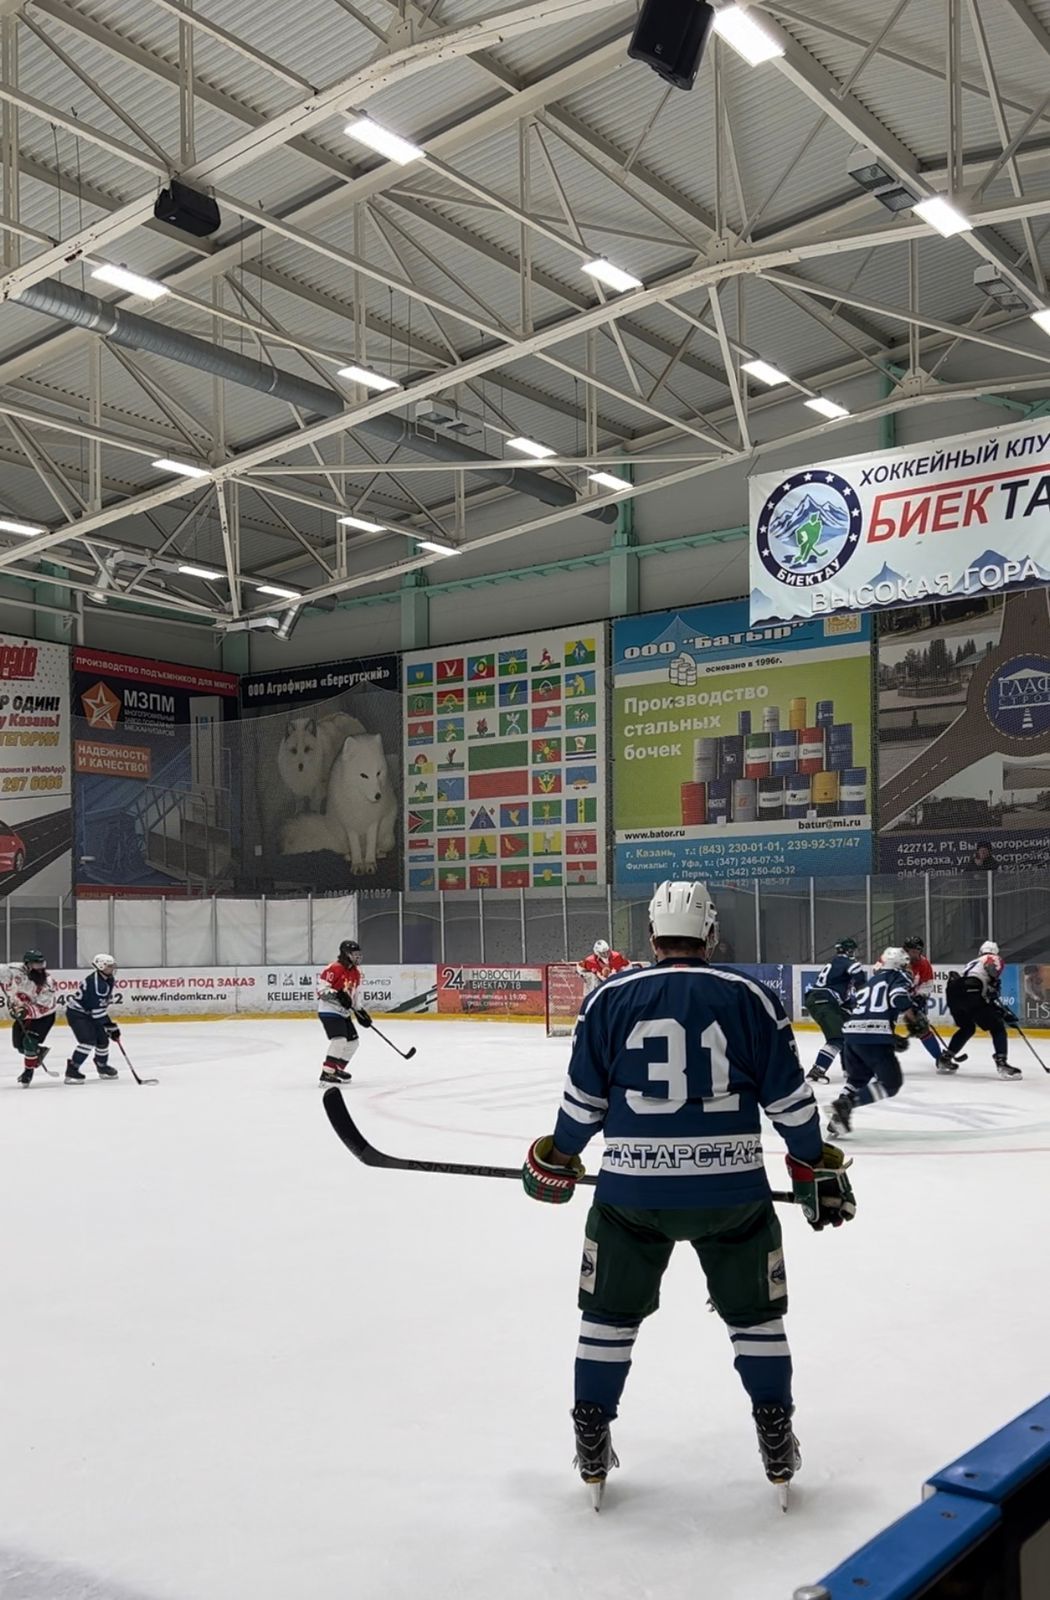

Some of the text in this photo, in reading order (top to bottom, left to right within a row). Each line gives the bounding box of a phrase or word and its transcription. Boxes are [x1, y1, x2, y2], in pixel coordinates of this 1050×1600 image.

[860, 440, 998, 486] ХОККЕЙНЫЙ
[777, 558, 840, 587] БИЕКТАУ
[811, 559, 1041, 613] ВЫСОКАЯ ГОРА
[624, 641, 676, 659] ООО
[76, 656, 138, 674] ПРОИЗВОДСТВО
[706, 660, 746, 673] основано
[756, 657, 782, 668] 1996г.
[266, 678, 317, 696] Агрофирма
[320, 666, 390, 688] «Берсутский»
[13, 697, 60, 713] ОДИН!
[124, 689, 175, 713] МЗПМ
[624, 685, 769, 716] Производство
[624, 715, 720, 737] стальных
[78, 745, 148, 761] НАДЕЖНОСТЬ
[624, 743, 681, 760] бочек
[78, 757, 148, 773] И КАЧЕСТВО!
[624, 829, 685, 841] www.bator.ru
[698, 843, 726, 856] (843)
[728, 842, 784, 855] 230-01-01,
[188, 978, 214, 988] ПОД
[217, 977, 256, 987] ЗАКАЗ
[442, 966, 466, 990] 24
[472, 970, 521, 980] НОВОСТИ
[816, 963, 832, 987] 8
[472, 982, 521, 990] БИЕКТАУ ТВ
[131, 992, 227, 1002] www.findomkzn.ru
[268, 992, 314, 1001] КЕШЕНЕ
[363, 992, 392, 1001] БИЗИ
[852, 981, 889, 1015] 20
[625, 1018, 740, 1115] 31
[433, 1164, 506, 1178] NEXUS
